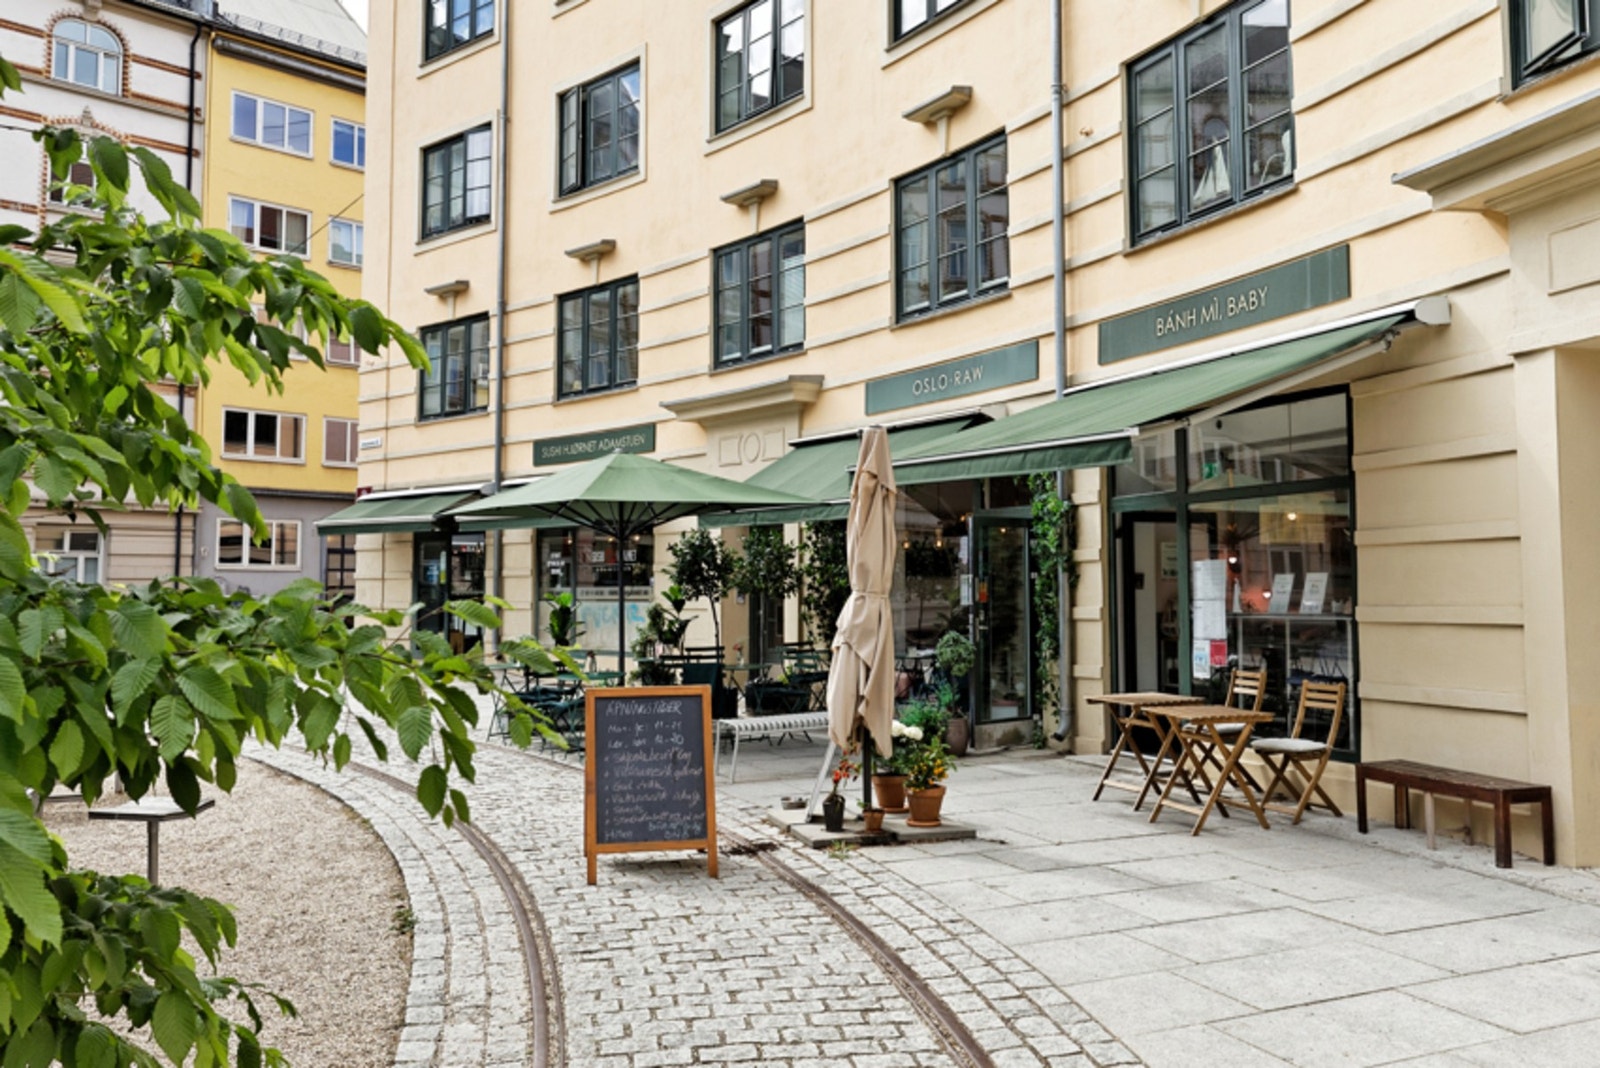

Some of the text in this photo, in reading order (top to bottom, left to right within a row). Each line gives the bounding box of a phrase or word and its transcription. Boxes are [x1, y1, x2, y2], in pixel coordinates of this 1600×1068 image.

[1156, 308, 1197, 337] BÁNH
[1227, 286, 1268, 317] BABY
[912, 365, 984, 396] OSLO RAW
[541, 446, 561, 459] SUSHI
